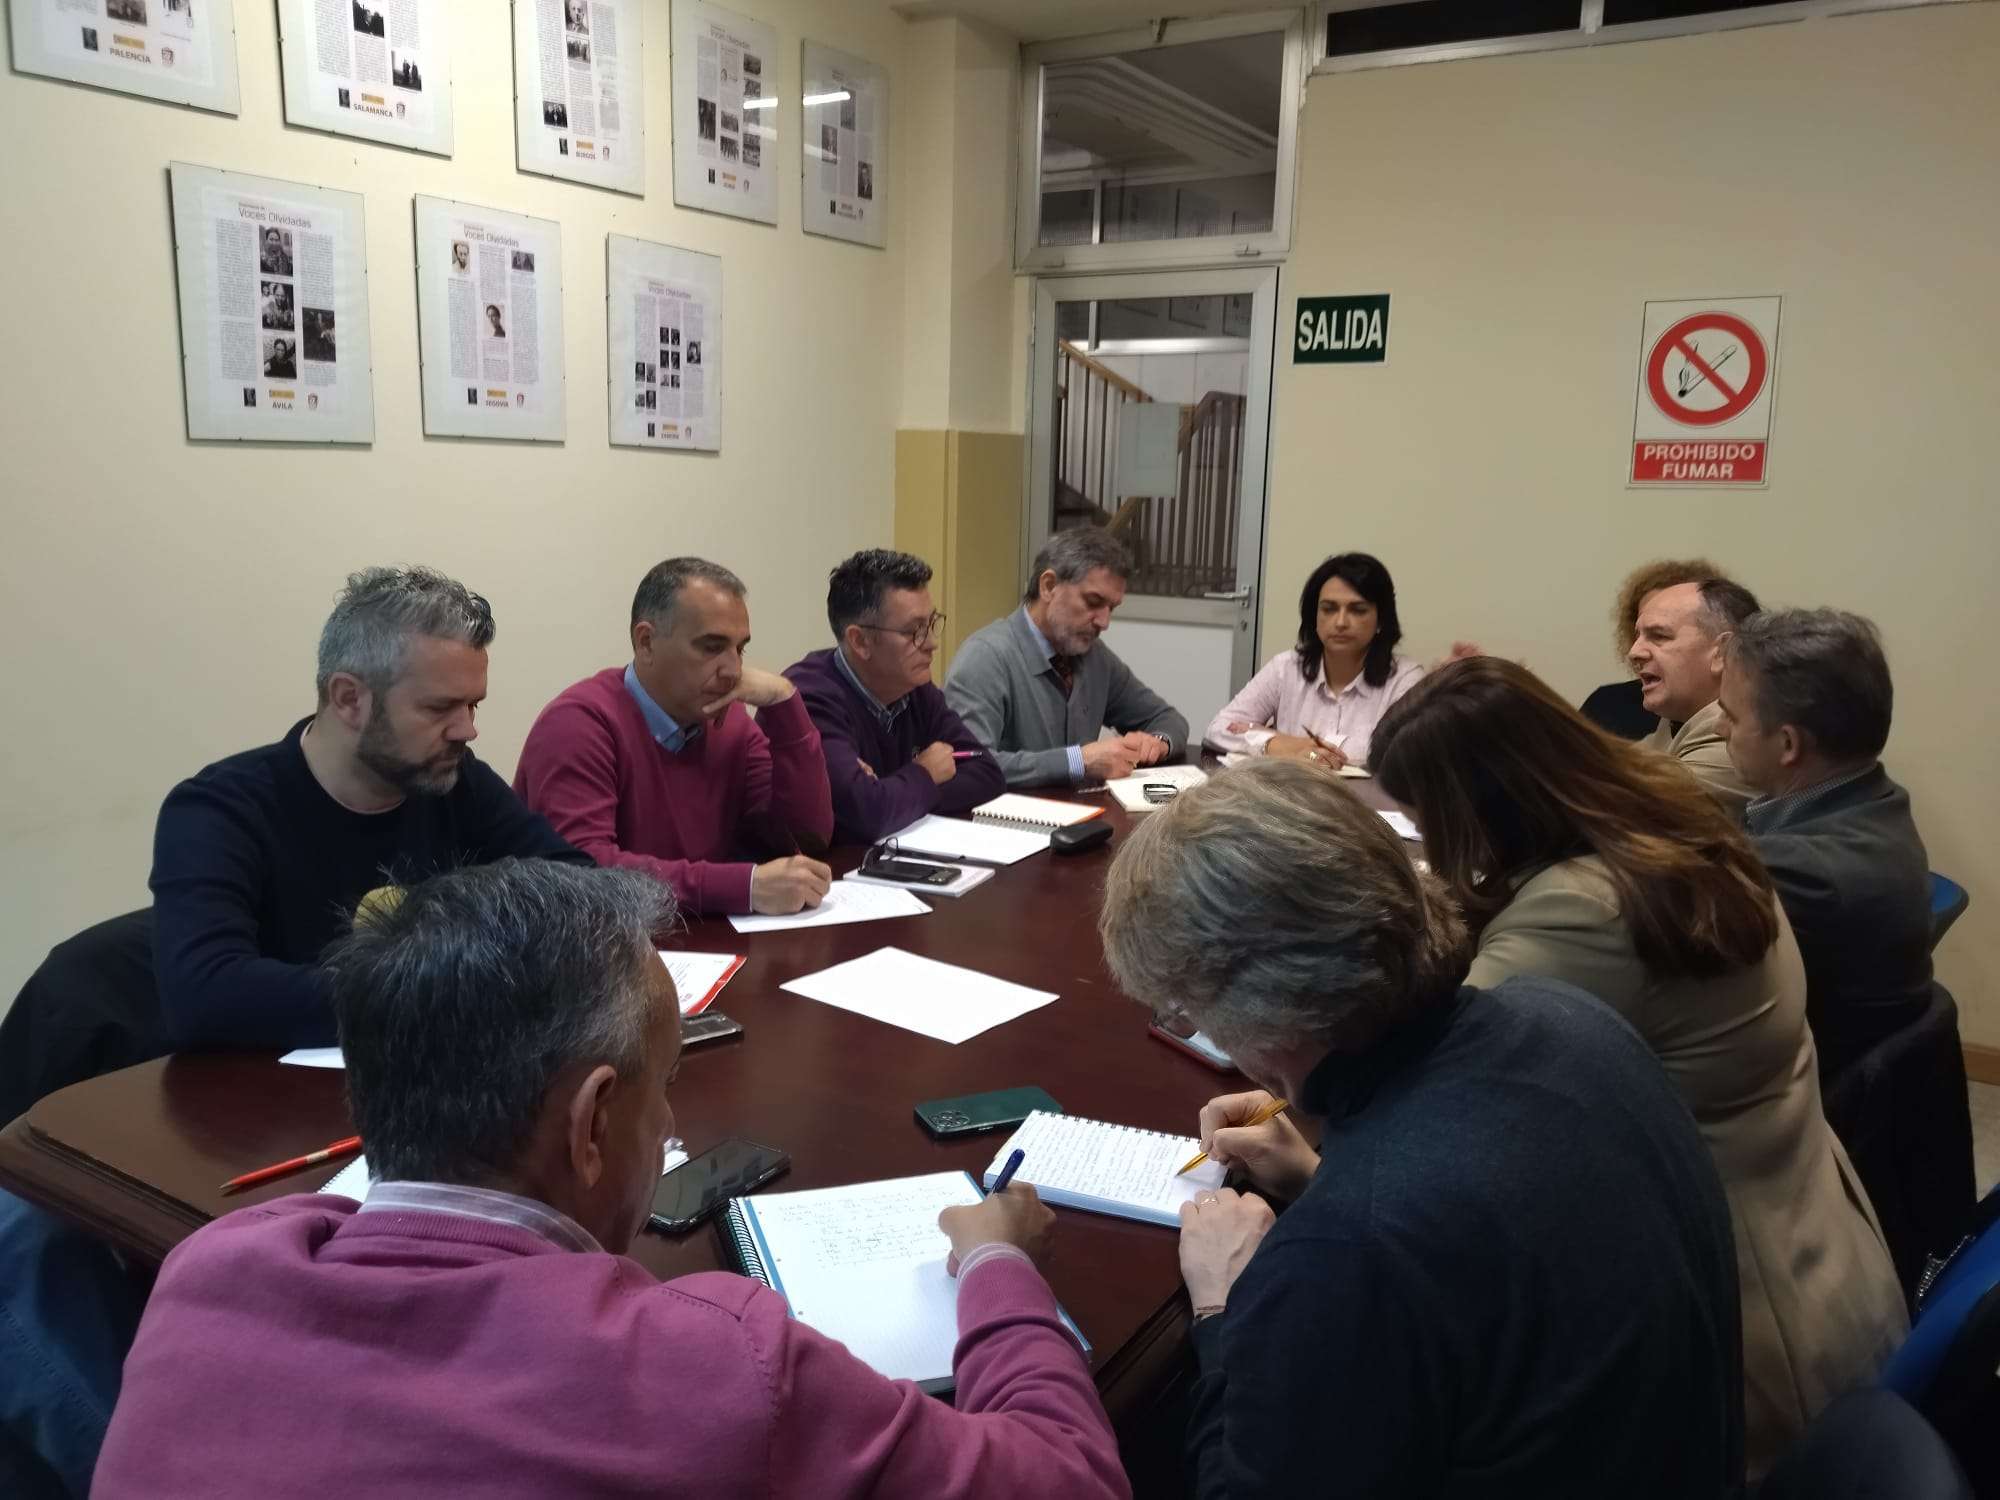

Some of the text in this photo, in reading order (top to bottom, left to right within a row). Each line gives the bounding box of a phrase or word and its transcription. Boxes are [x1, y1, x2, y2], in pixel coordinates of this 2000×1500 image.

[353, 103, 393, 117] SALAMANCA
[239, 207, 266, 221] Voces
[1298, 308, 1383, 351] SALIDA
[1643, 443, 1756, 461] PROHIBIDO
[1661, 462, 1734, 479] FUMAR
